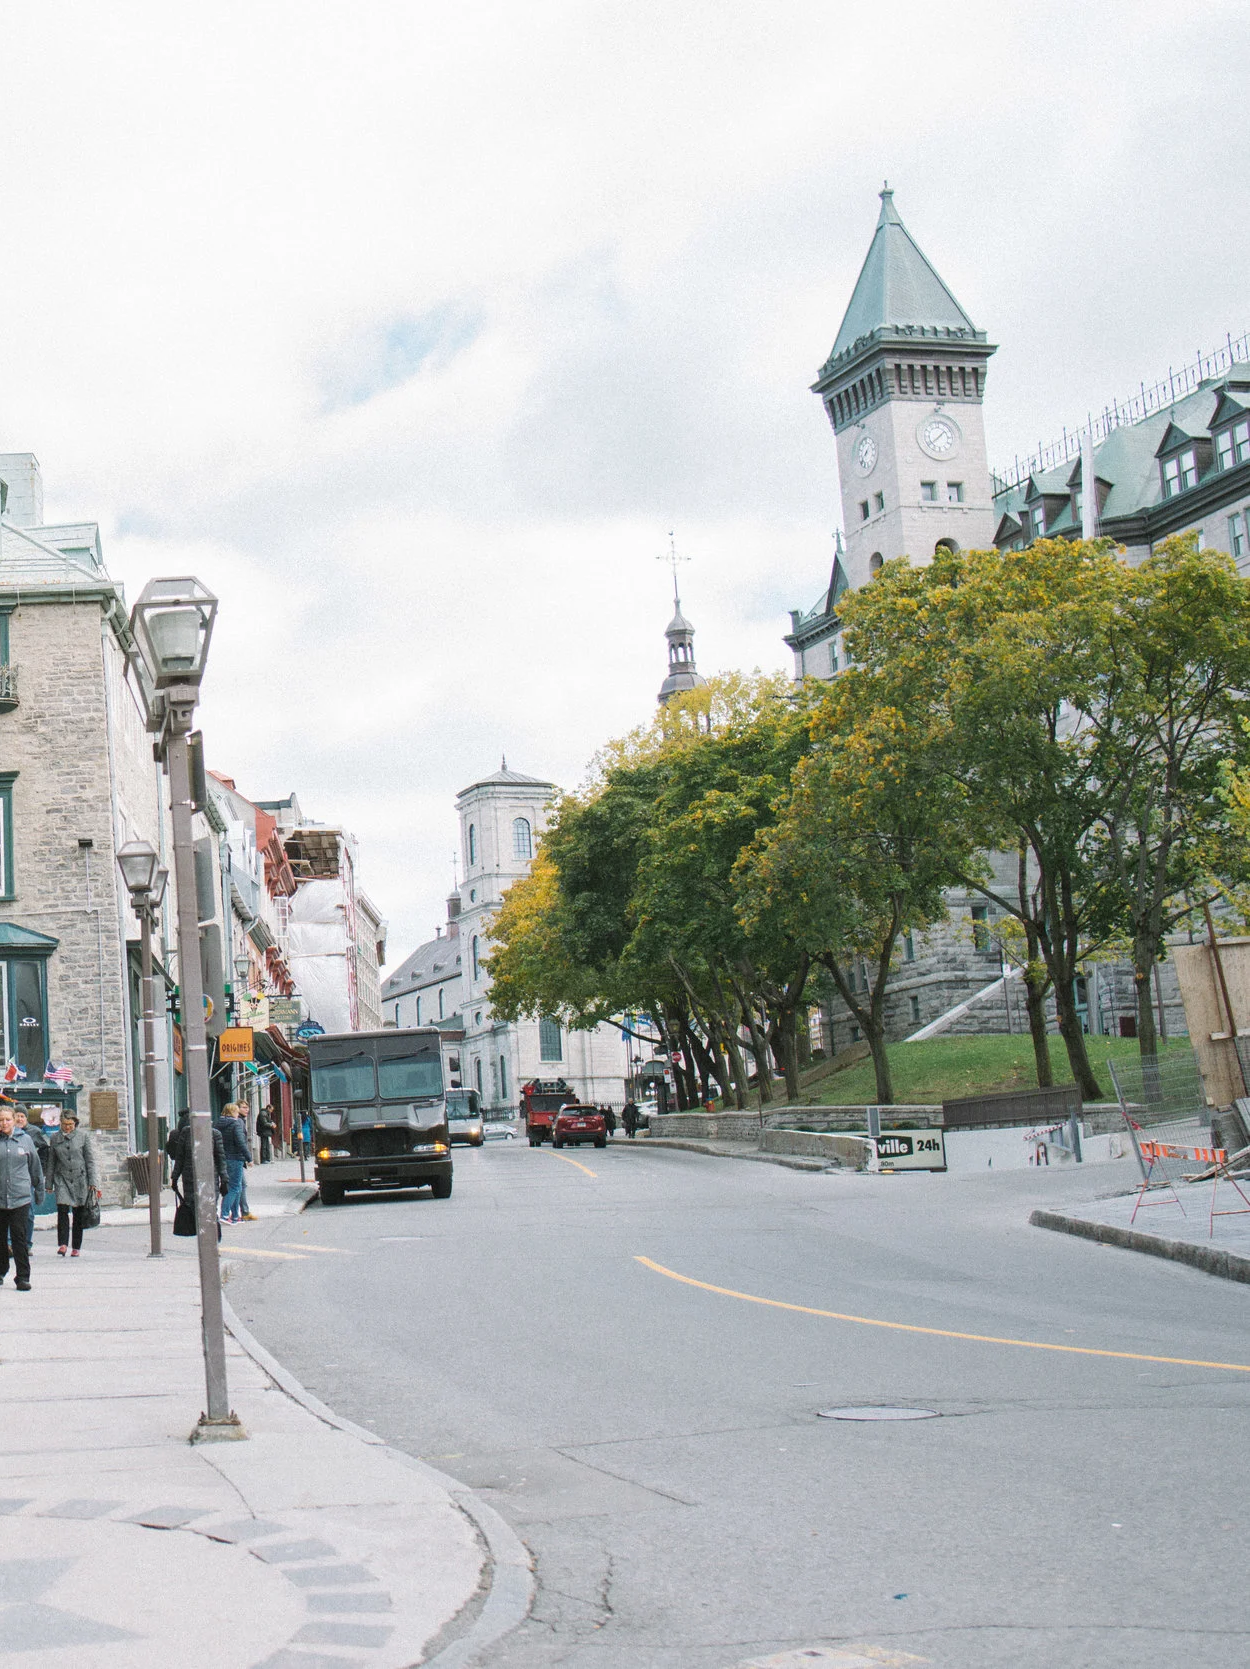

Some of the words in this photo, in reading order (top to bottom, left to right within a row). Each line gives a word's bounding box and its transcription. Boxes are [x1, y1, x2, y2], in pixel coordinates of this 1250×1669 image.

[222, 1043, 251, 1053] ORIGINES
[877, 1139, 908, 1154] ville
[917, 1138, 940, 1152] 24h
